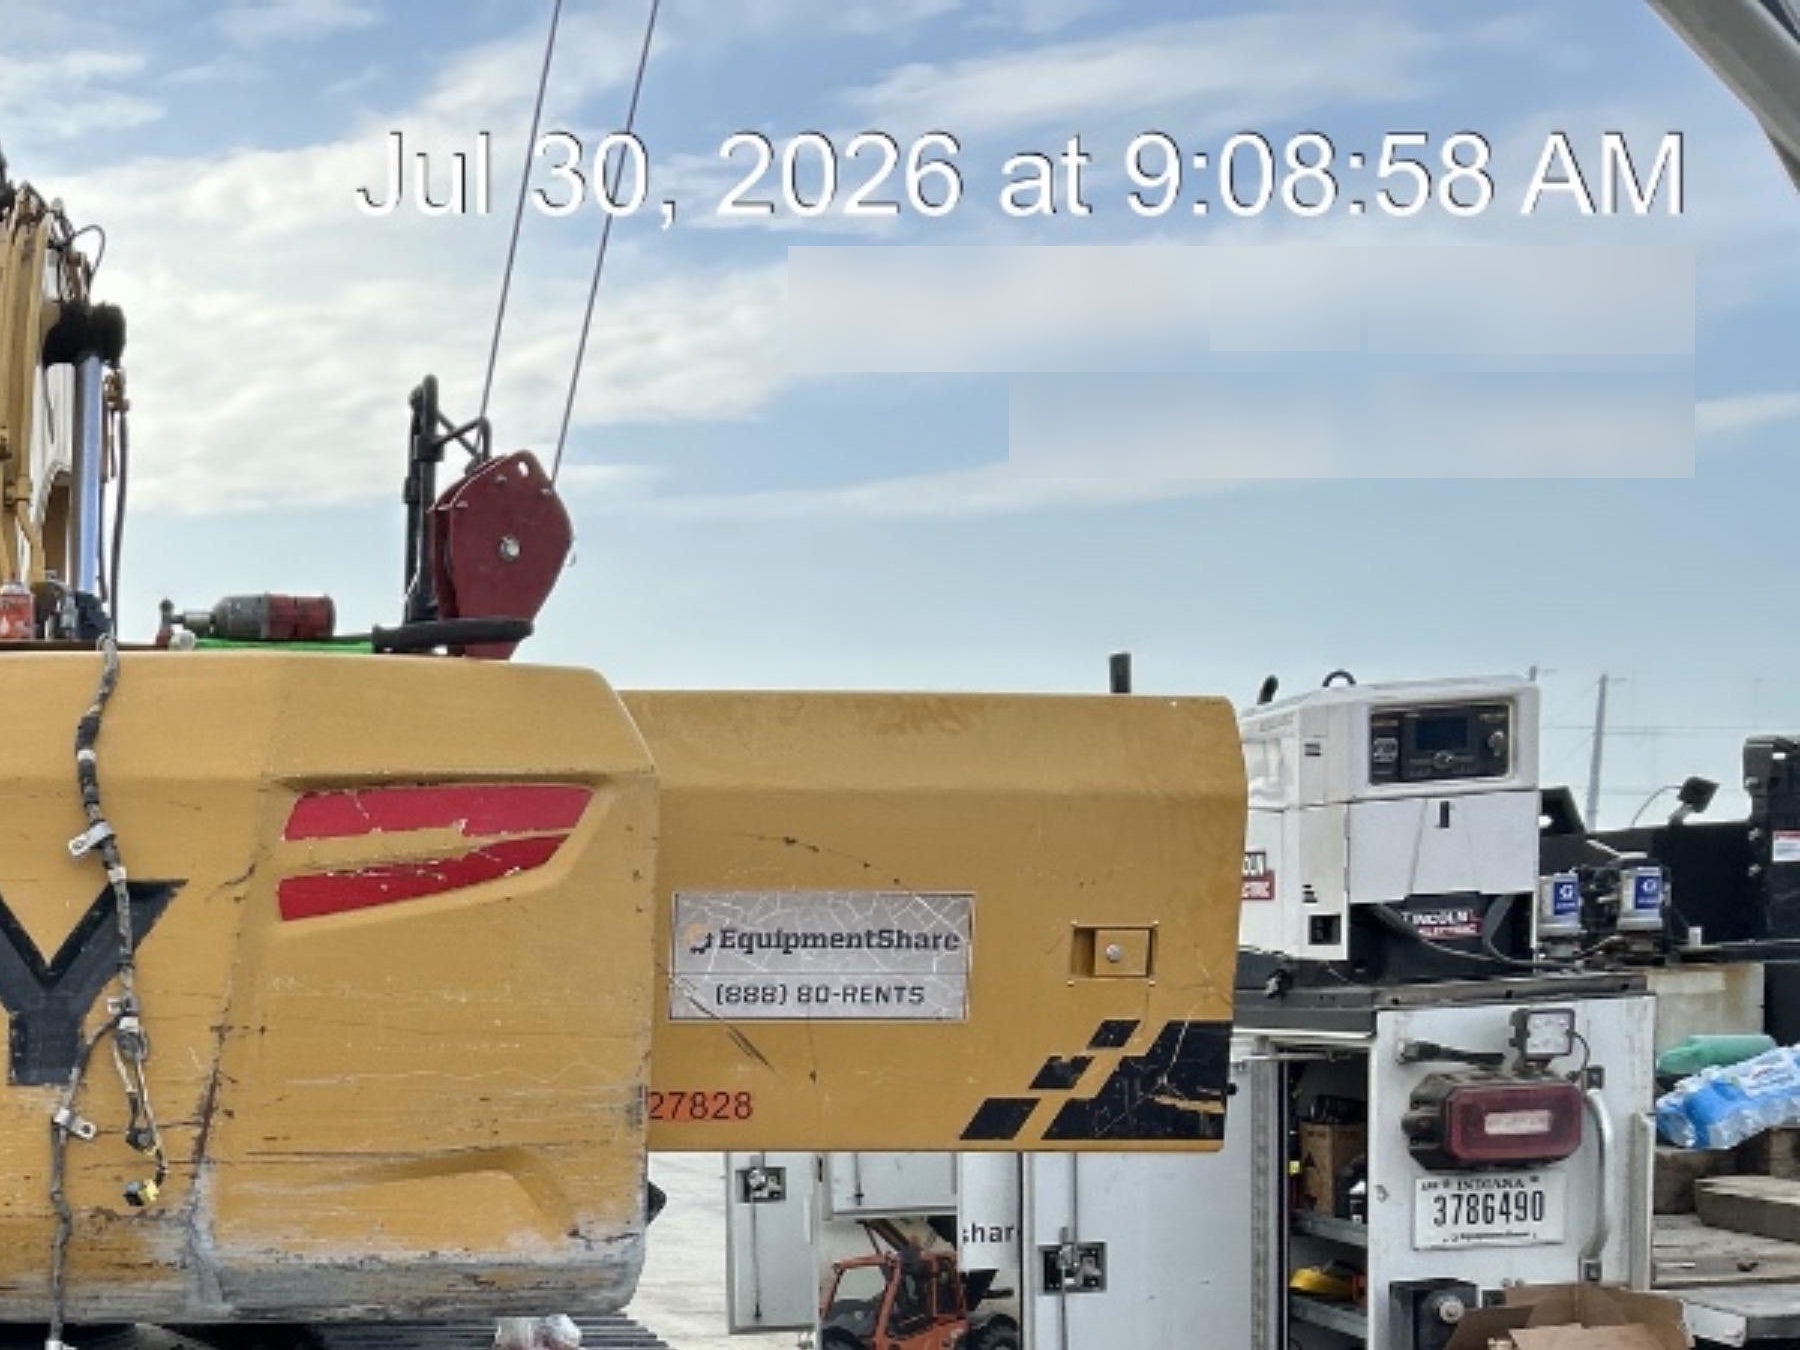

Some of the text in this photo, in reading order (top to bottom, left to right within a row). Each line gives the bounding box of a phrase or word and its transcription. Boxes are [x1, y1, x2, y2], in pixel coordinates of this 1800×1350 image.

[718, 927, 961, 954] EquipmentShare
[715, 983, 926, 1005] (888) 80-RENTS
[648, 1091, 752, 1120] 27828
[1433, 1190, 1545, 1227] 3786490
